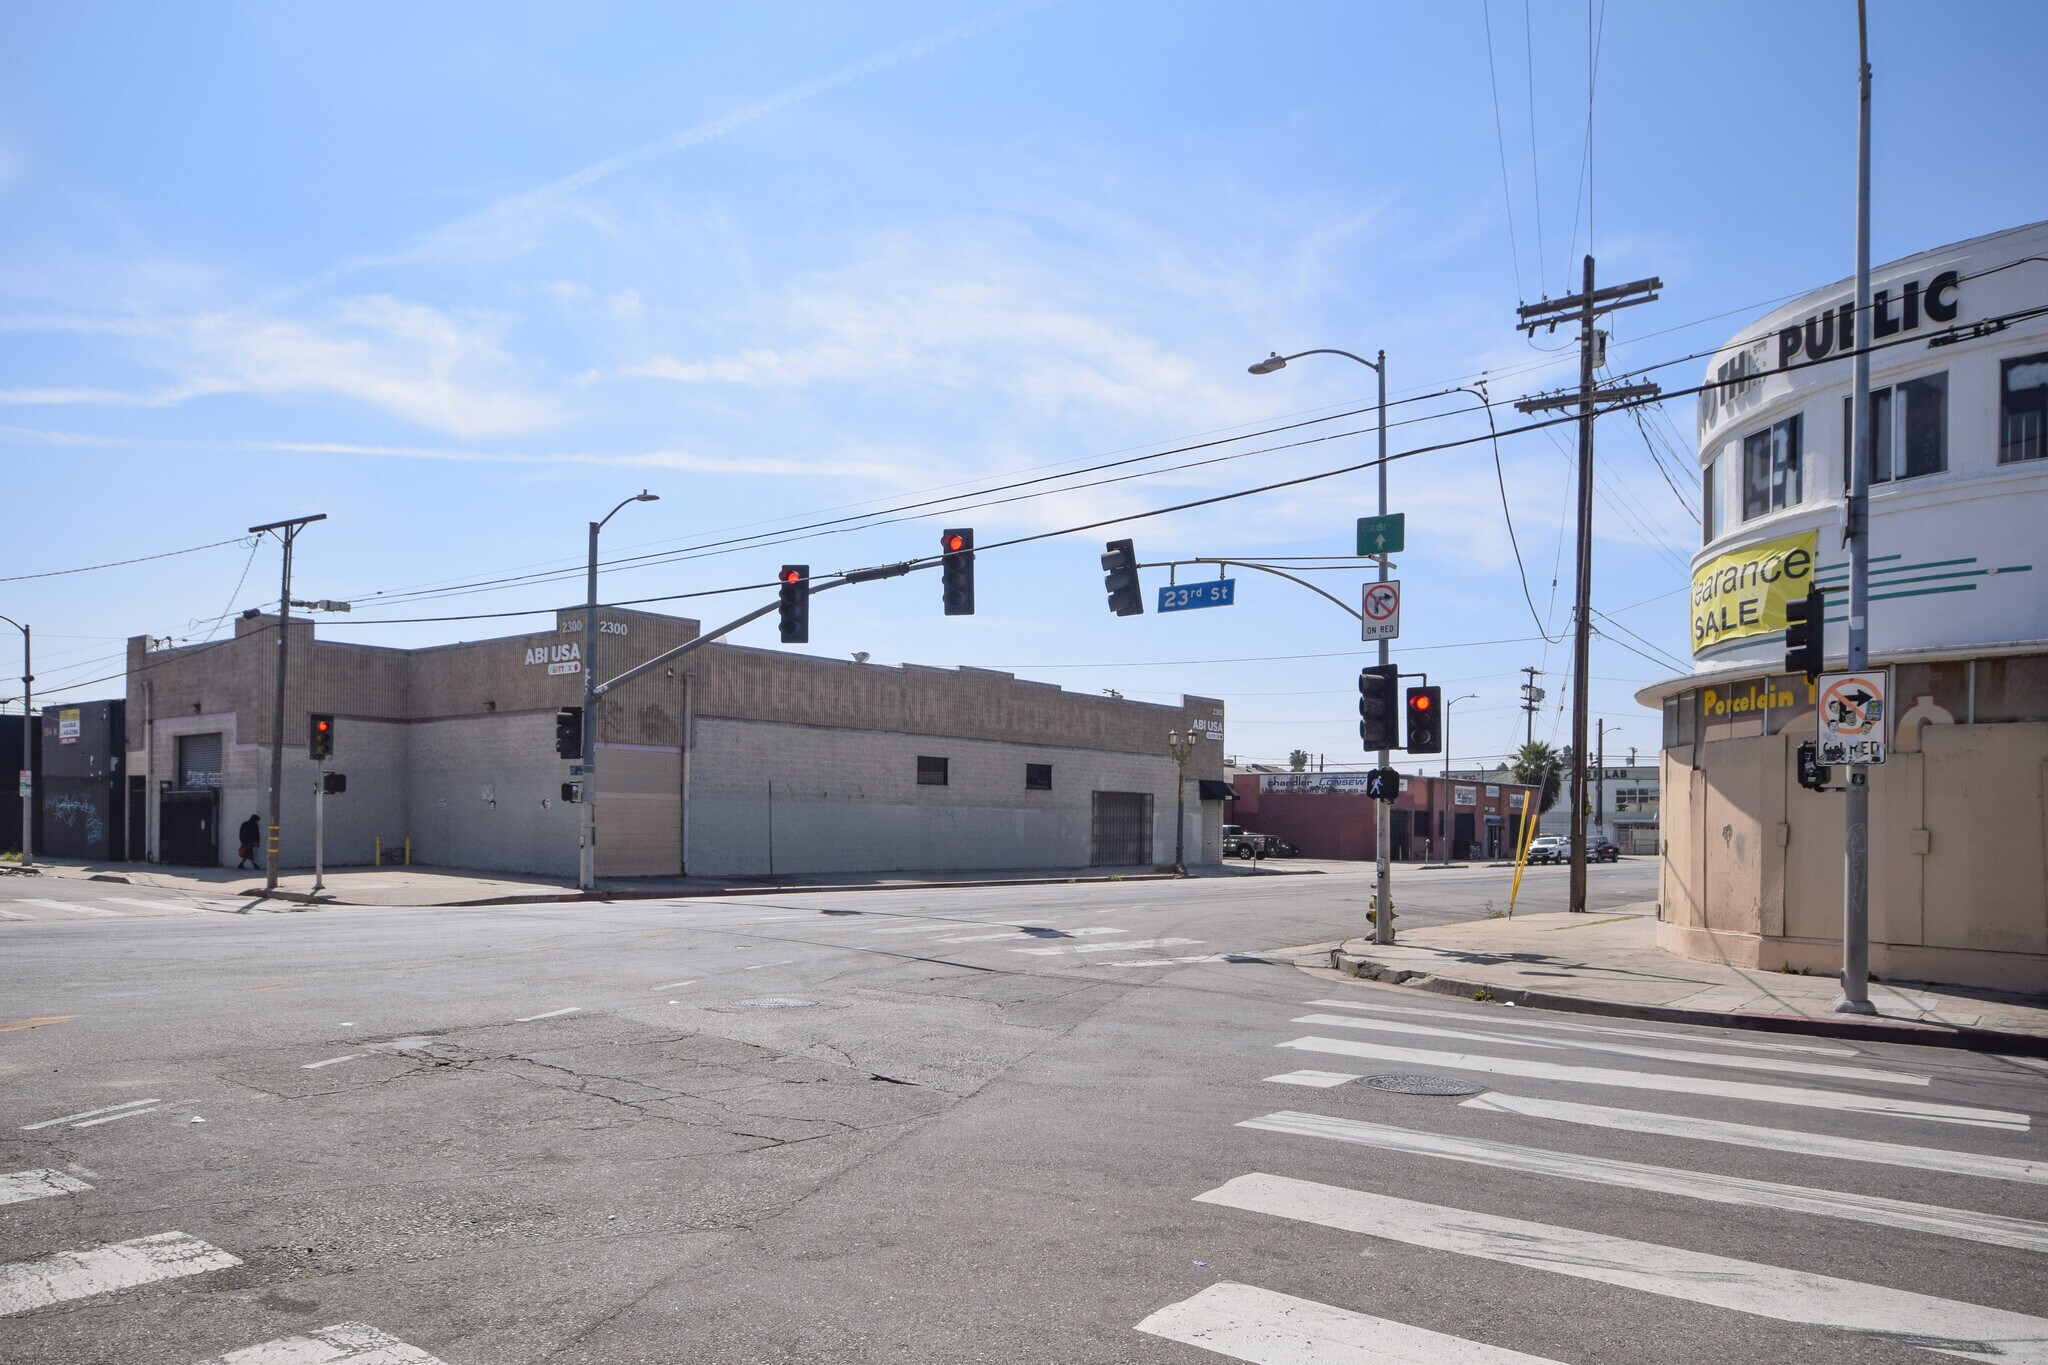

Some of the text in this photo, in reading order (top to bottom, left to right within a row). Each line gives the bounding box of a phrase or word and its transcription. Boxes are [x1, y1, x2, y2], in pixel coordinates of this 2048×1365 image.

[1163, 586, 1228, 608] 23rd St
[562, 620, 582, 633] 2300
[1695, 598, 1759, 641] SALE
[599, 621, 628, 636] 2300
[1366, 624, 1394, 635] ON RED
[524, 642, 581, 666] ABI USA
[1704, 684, 1794, 717] Porcelain
[1192, 718, 1224, 733] ABI USA
[1267, 775, 1367, 787] chandler CONSEW
[1605, 769, 1628, 778] LAB
